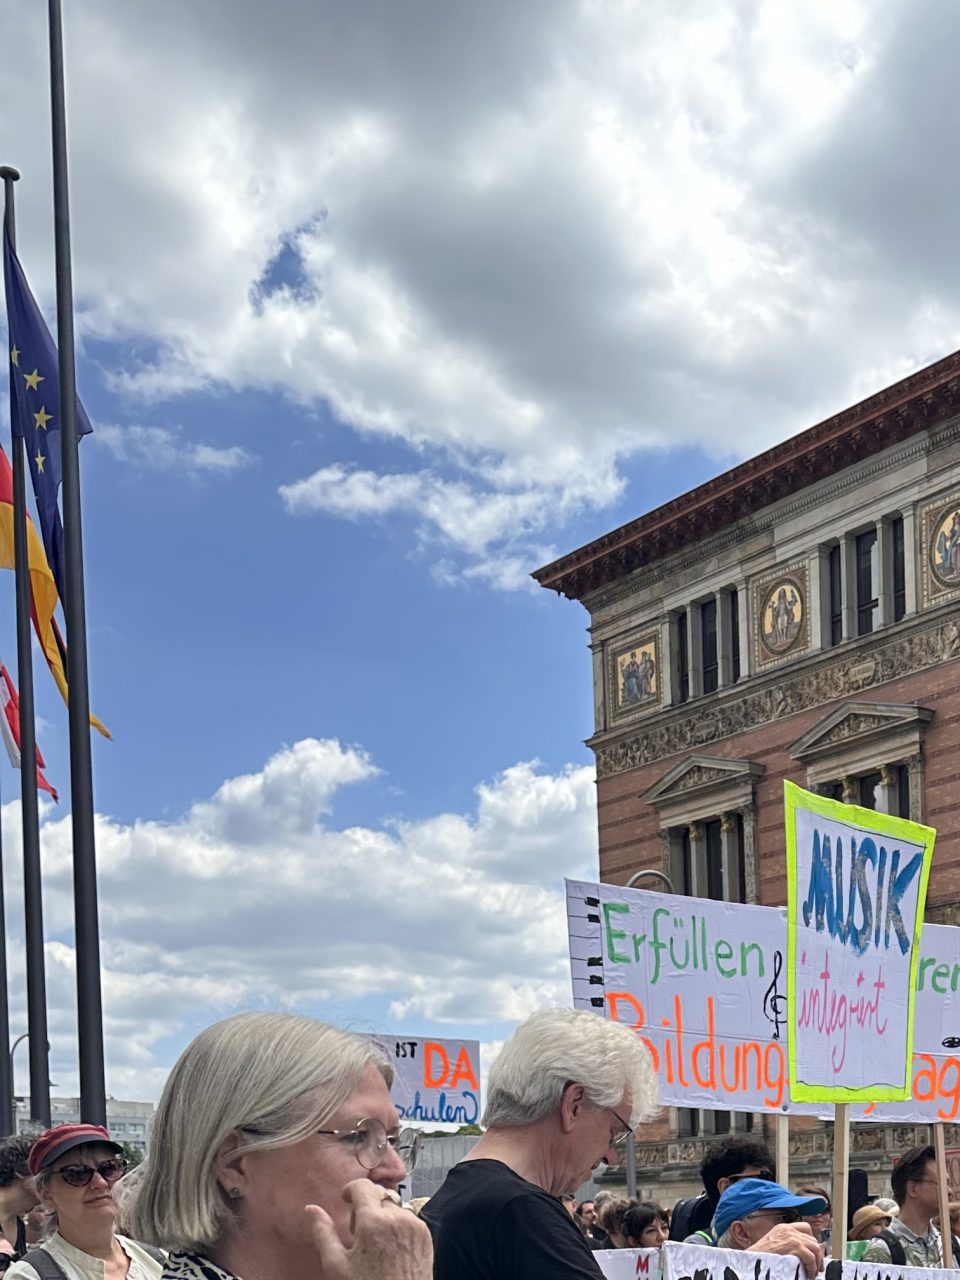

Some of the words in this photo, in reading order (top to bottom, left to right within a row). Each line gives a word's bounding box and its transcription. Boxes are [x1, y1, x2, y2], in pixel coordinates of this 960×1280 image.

[803, 828, 923, 957] MUSIK
[603, 903, 764, 985] Erfüllen
[396, 1041, 418, 1058] IST
[424, 1041, 479, 1091] DA
[605, 991, 790, 1108] Bildung
